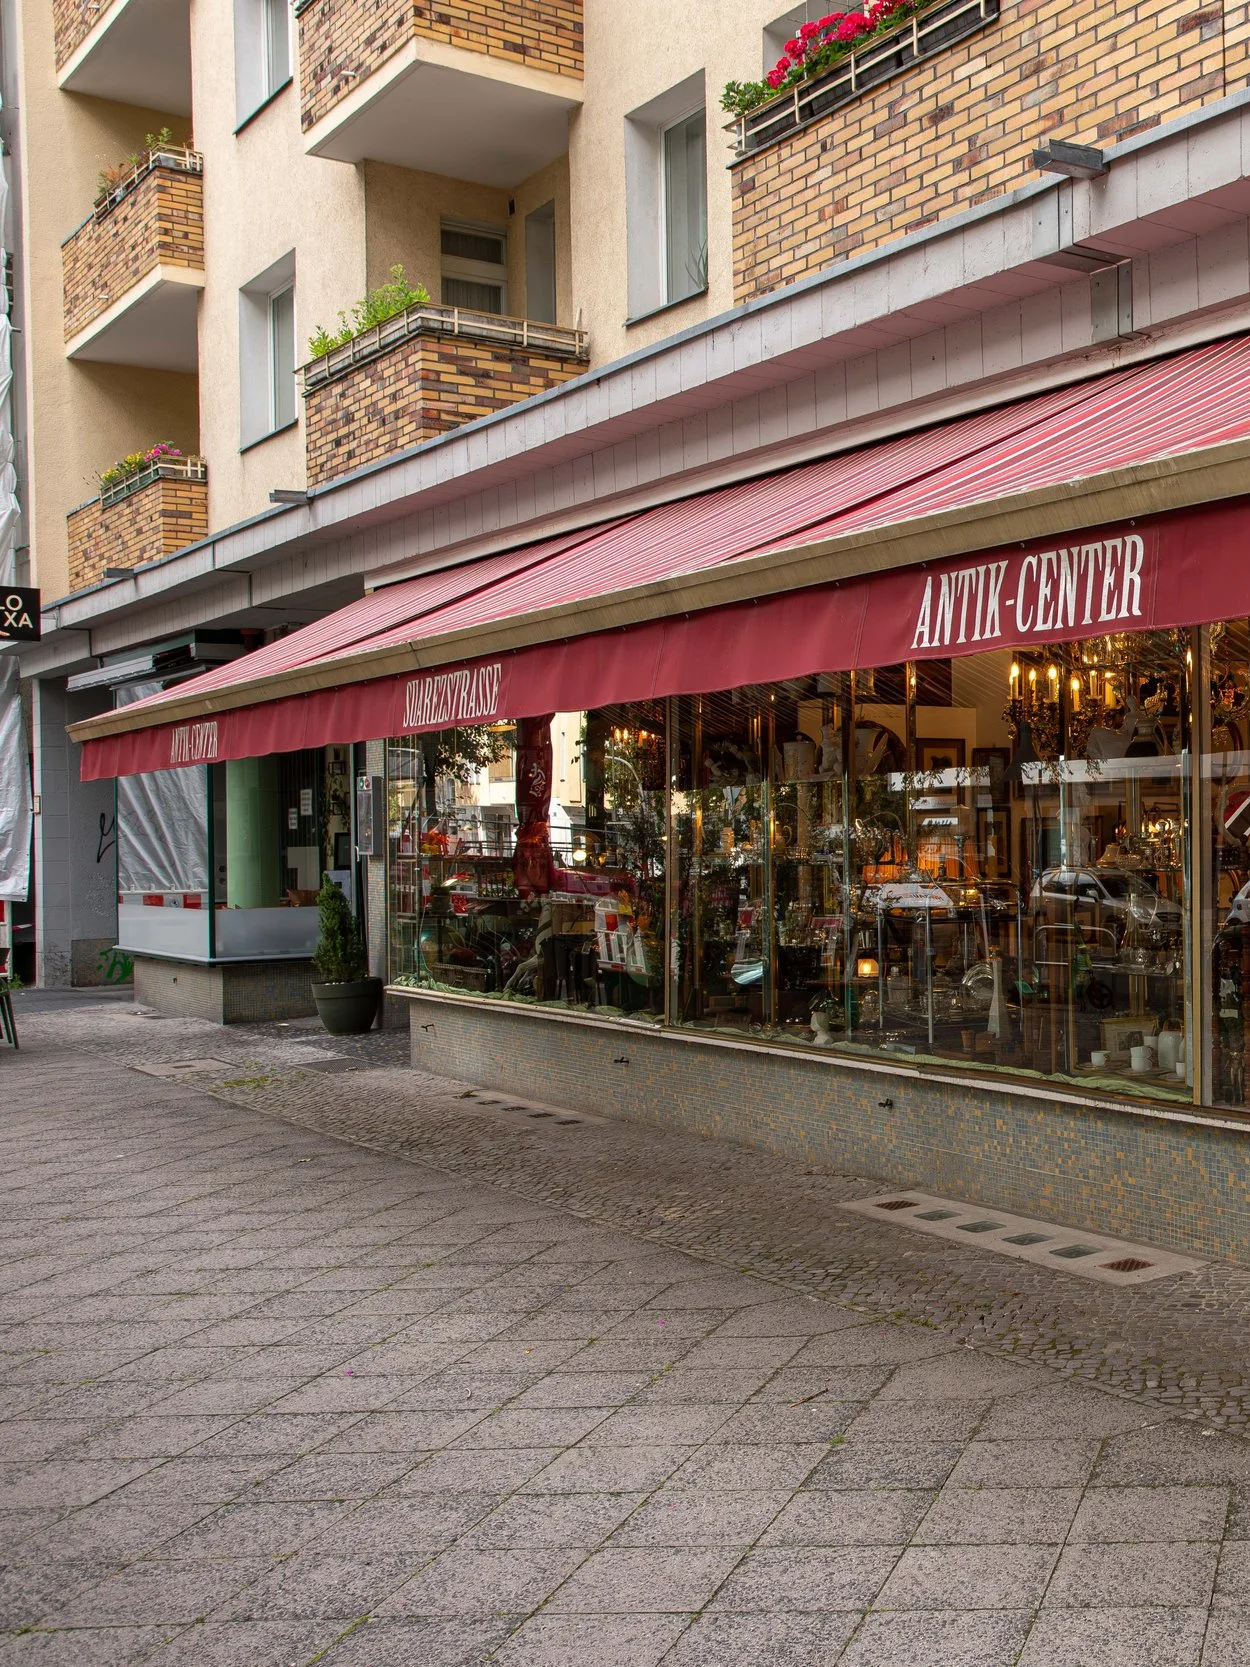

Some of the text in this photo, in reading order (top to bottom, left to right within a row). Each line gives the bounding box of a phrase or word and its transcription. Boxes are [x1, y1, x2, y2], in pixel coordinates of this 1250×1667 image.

[911, 534, 1144, 649] ANTIK-CENTER
[402, 663, 502, 728] SUAREZSTRASSE
[170, 720, 218, 763] ANTIK-CENTER
